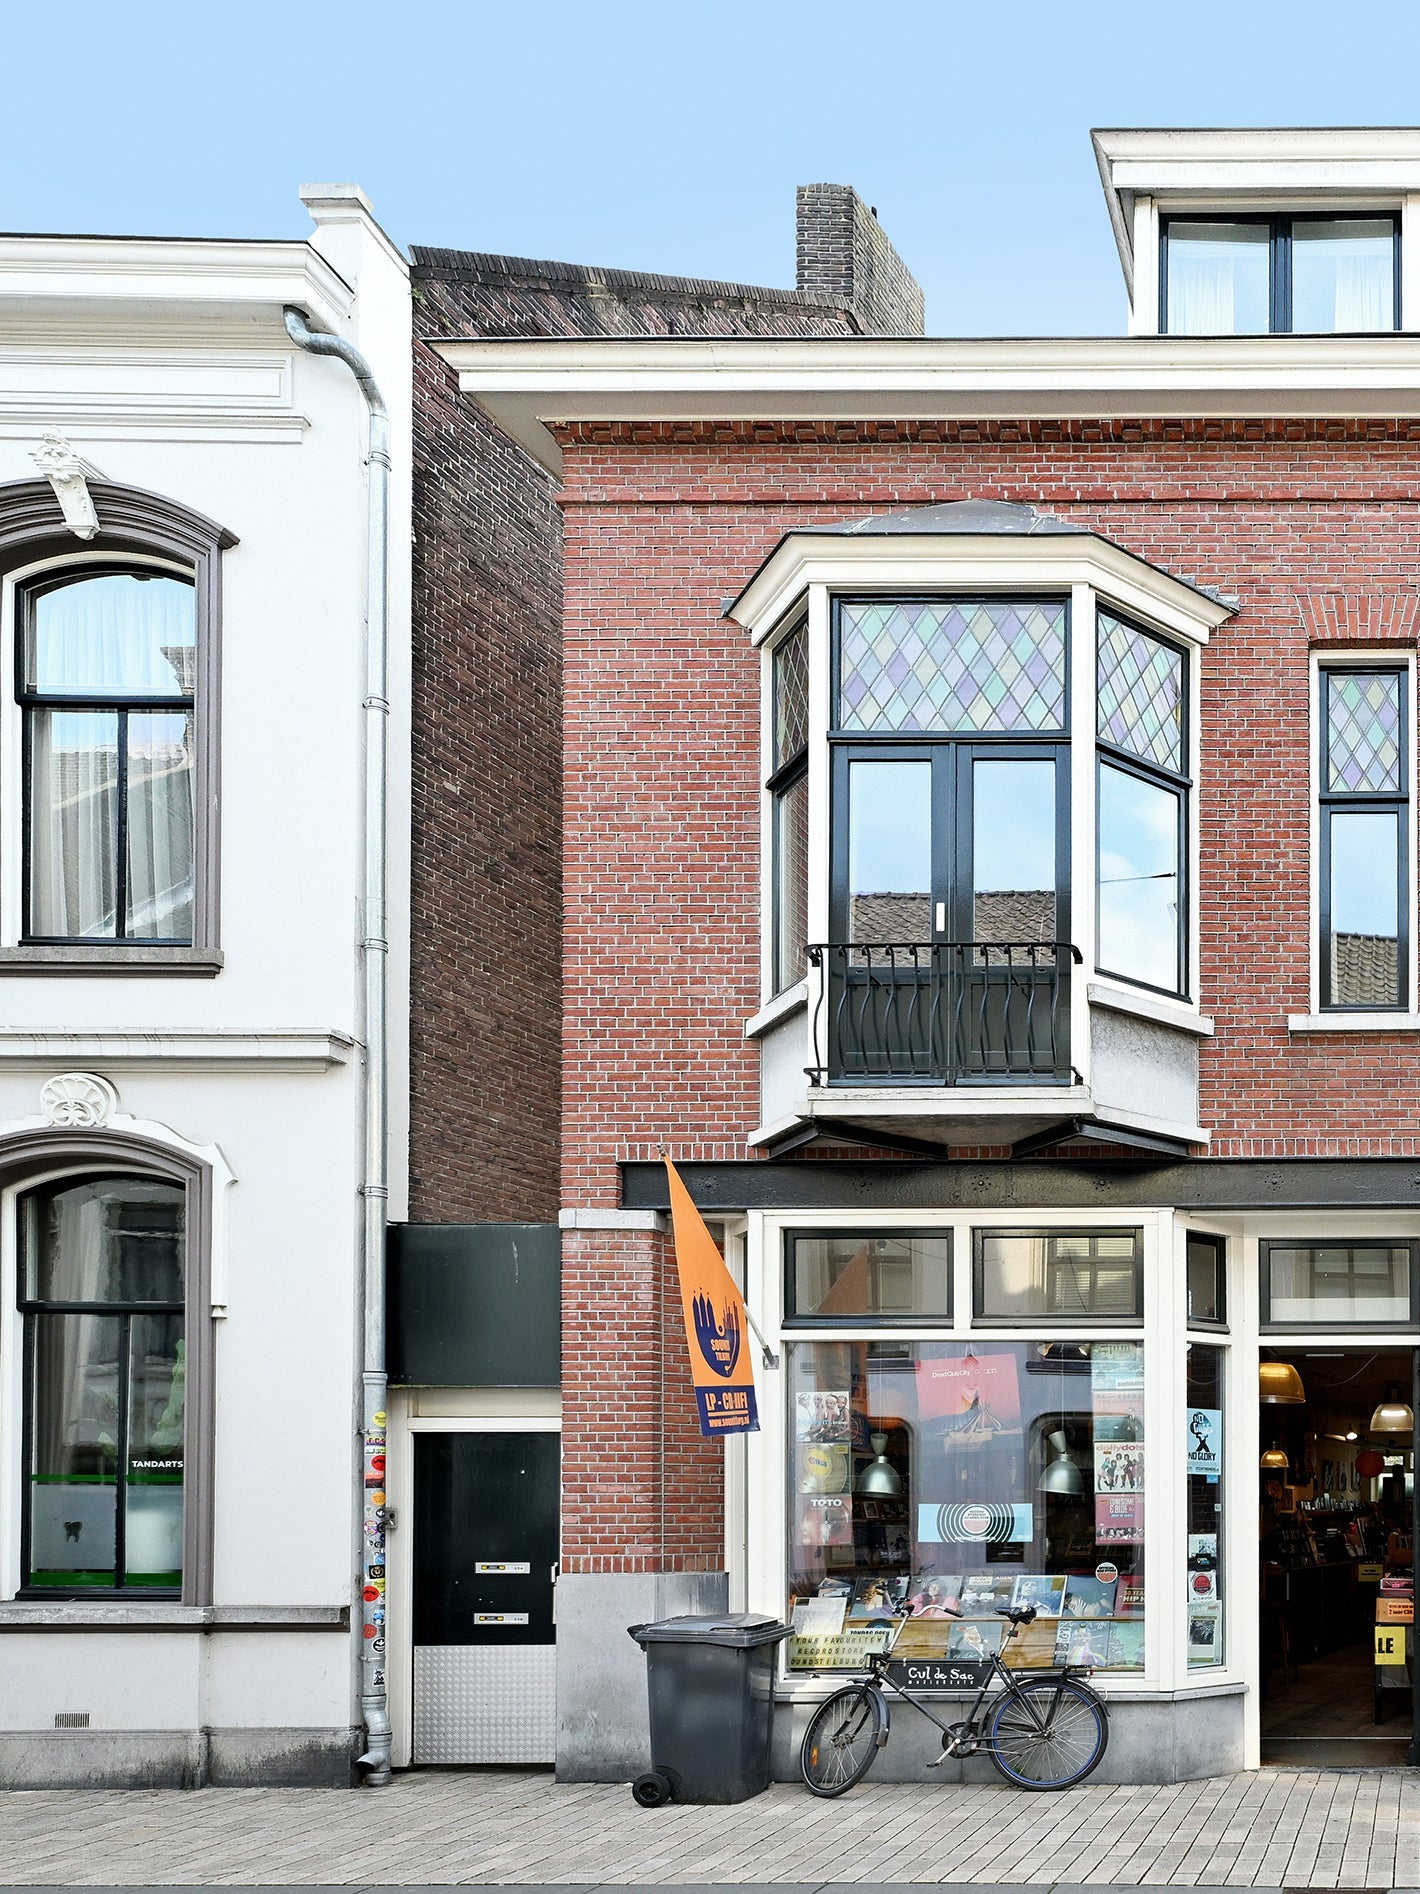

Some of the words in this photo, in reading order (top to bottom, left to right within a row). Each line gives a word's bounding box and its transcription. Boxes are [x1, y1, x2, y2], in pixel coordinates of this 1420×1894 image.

[705, 1392, 717, 1411] LP
[131, 1460, 184, 1468] TANDARTS
[810, 1499, 843, 1507] TOTO
[1375, 1637, 1394, 1654] LE
[908, 1666, 931, 1680] Cul
[934, 1667, 947, 1680] de
[950, 1668, 975, 1680] Sac
